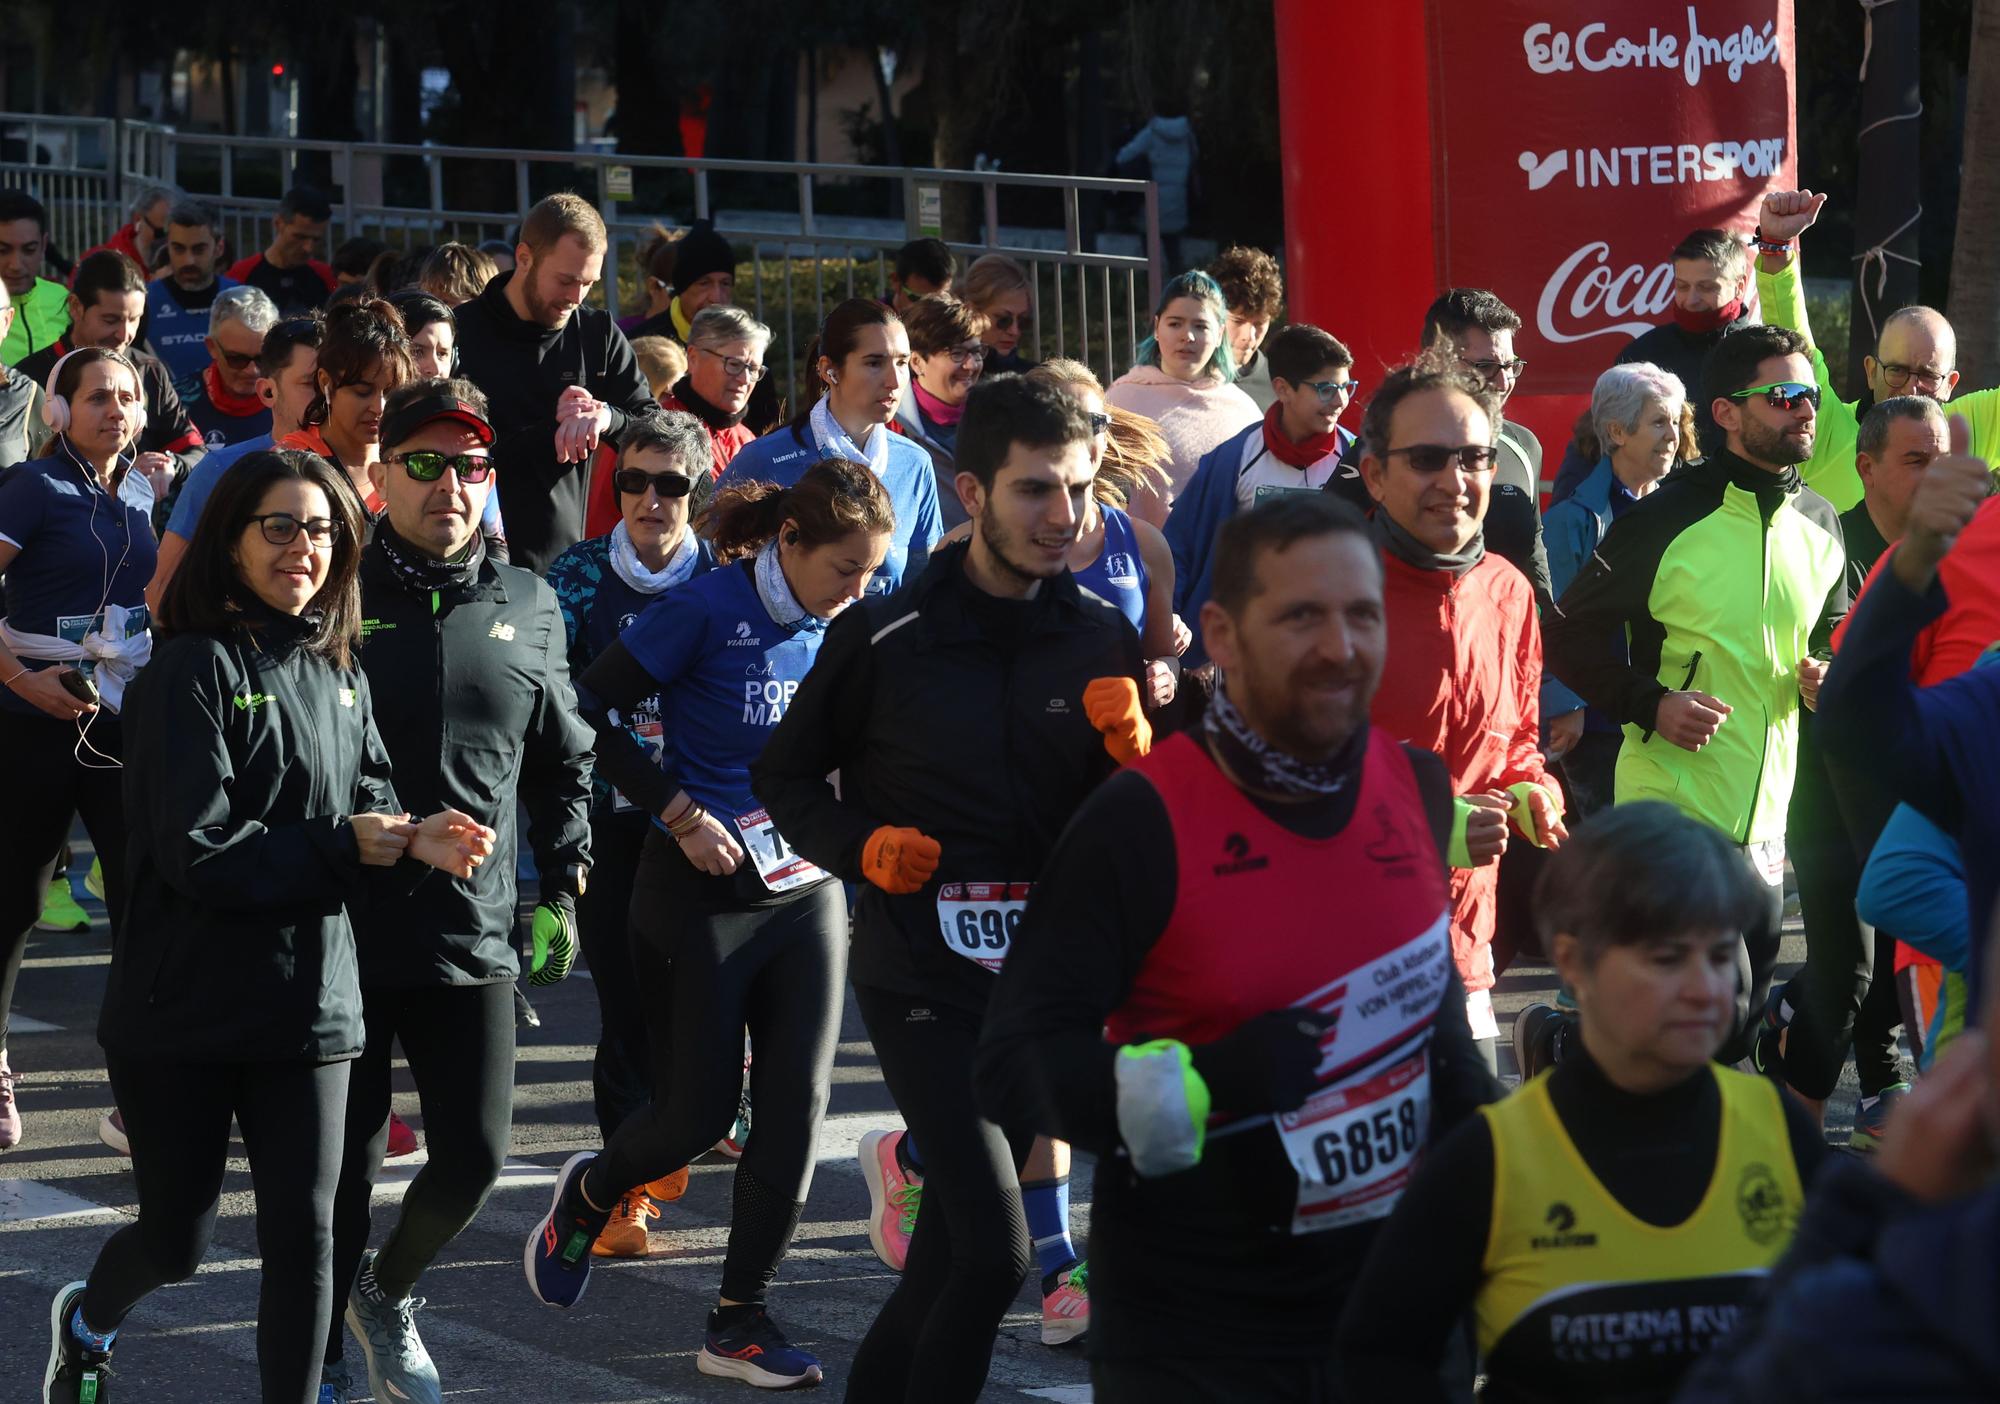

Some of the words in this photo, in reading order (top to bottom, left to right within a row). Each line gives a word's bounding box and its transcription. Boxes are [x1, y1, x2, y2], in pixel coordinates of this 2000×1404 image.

[1523, 22, 1573, 74] El
[1575, 22, 1679, 72] Corte
[1684, 5, 1780, 87] Inglés
[1575, 137, 1784, 188] INTERSPORT
[1537, 241, 1676, 343] Coca
[161, 333, 206, 345] STAD
[772, 450, 798, 464] luanvi
[361, 618, 380, 626] LENCIA
[726, 638, 761, 647] VIATOR
[745, 660, 777, 676] C.A.
[745, 680, 799, 705] POB
[742, 703, 788, 726] MA
[762, 827, 795, 861] 7
[1372, 962, 1400, 986] Club
[1356, 992, 1388, 1019] VON
[1312, 1098, 1417, 1186] 6858
[1551, 1308, 1681, 1342] PATERNA
